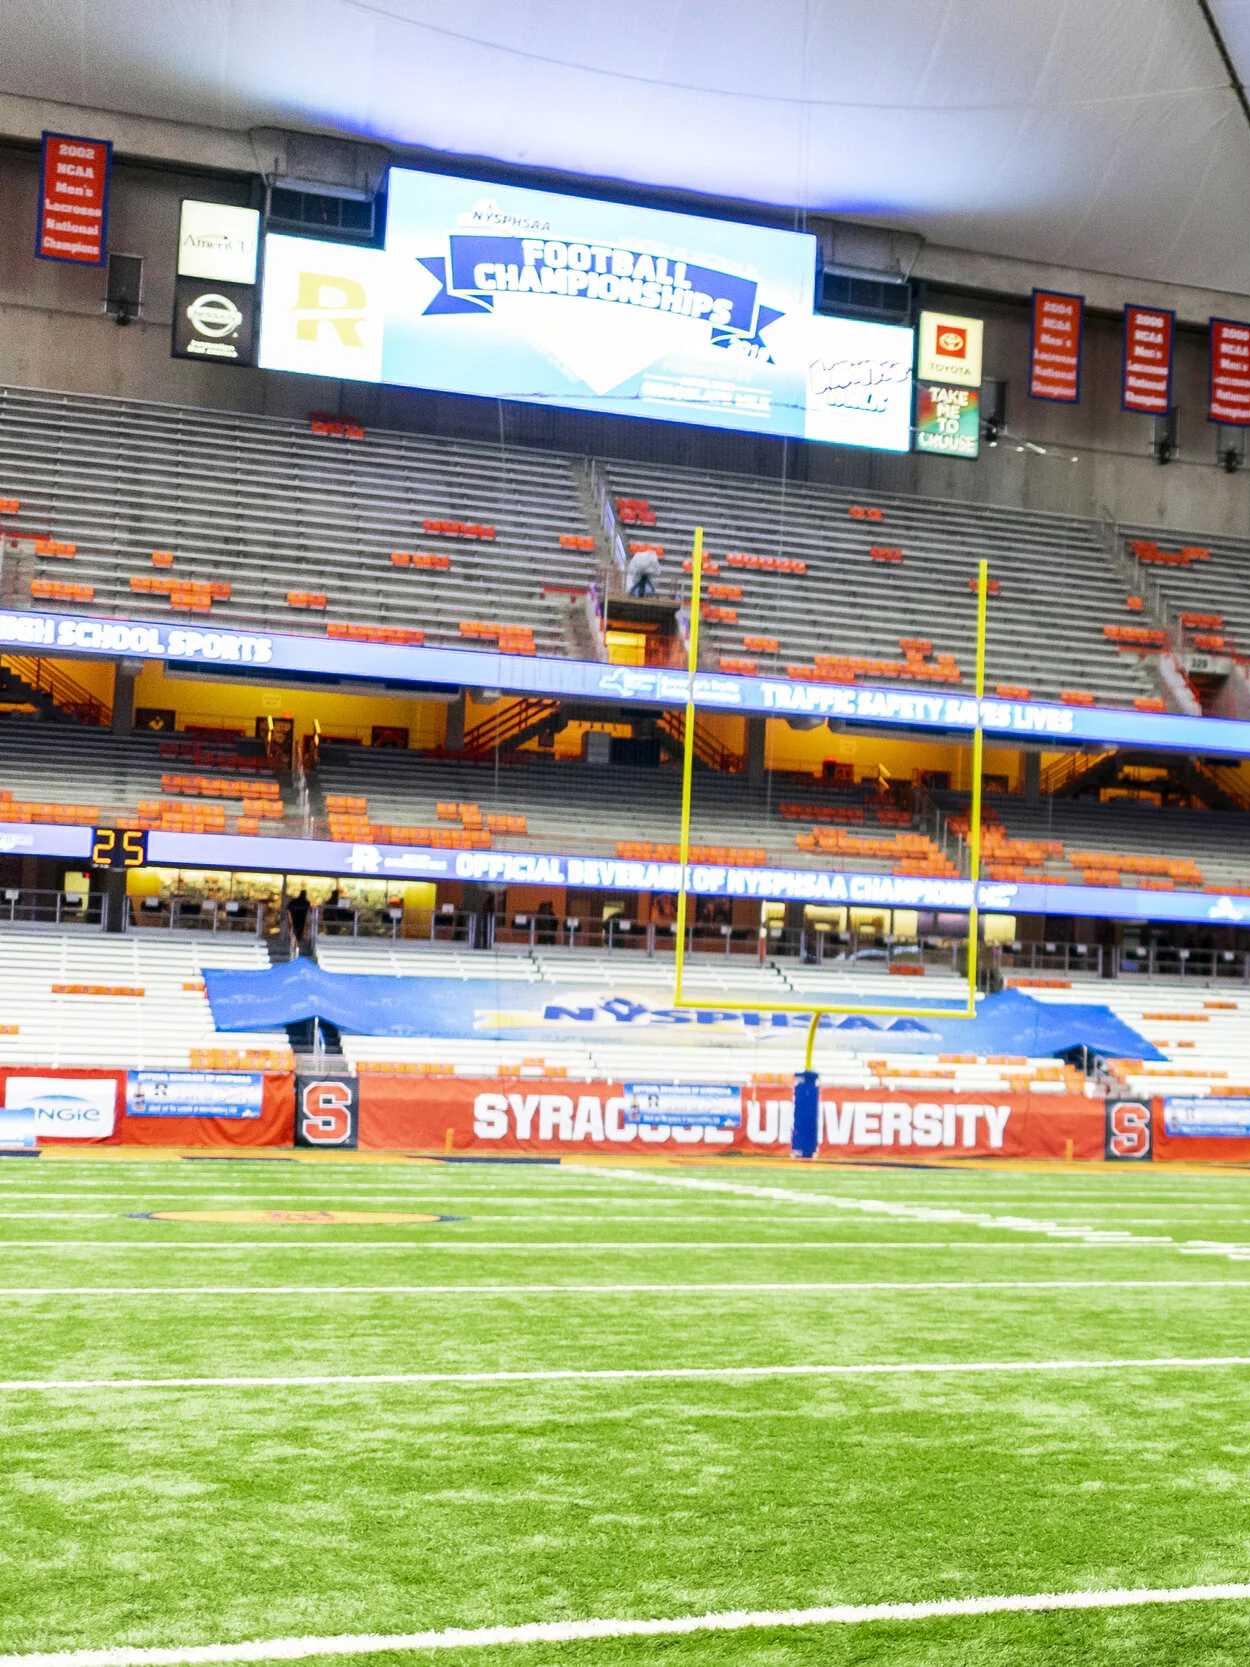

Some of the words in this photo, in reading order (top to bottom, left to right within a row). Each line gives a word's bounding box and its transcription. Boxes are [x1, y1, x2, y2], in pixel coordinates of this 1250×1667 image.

[57, 162, 94, 178] NCAA
[59, 144, 95, 160] 2002
[55, 181, 94, 197] Men's
[46, 218, 99, 236] National
[521, 239, 692, 290] FOOTBALL
[290, 271, 368, 349] R
[473, 262, 734, 325] CHAMPIONSHIPS
[928, 361, 972, 377] TOYOTA
[929, 386, 969, 406] TAKE
[936, 402, 960, 420] ME
[937, 418, 960, 435] TO
[58, 620, 165, 654] SCHOOL
[167, 630, 273, 663] SPORTS
[761, 683, 856, 712] TRAFFIC
[857, 692, 945, 720] SAFETY
[945, 700, 1010, 727] SAVES
[1013, 706, 1073, 732] LIVES
[94, 830, 144, 865] 25
[455, 853, 564, 883] OFFICIAL
[567, 859, 690, 890] BEVERAGE
[690, 866, 727, 893] OF
[728, 869, 847, 901] NYSPHSAA
[303, 1082, 352, 1144] S
[473, 1092, 735, 1144] SYRAC
[746, 1099, 1012, 1148] UVERSITY
[1109, 1102, 1151, 1158] S
